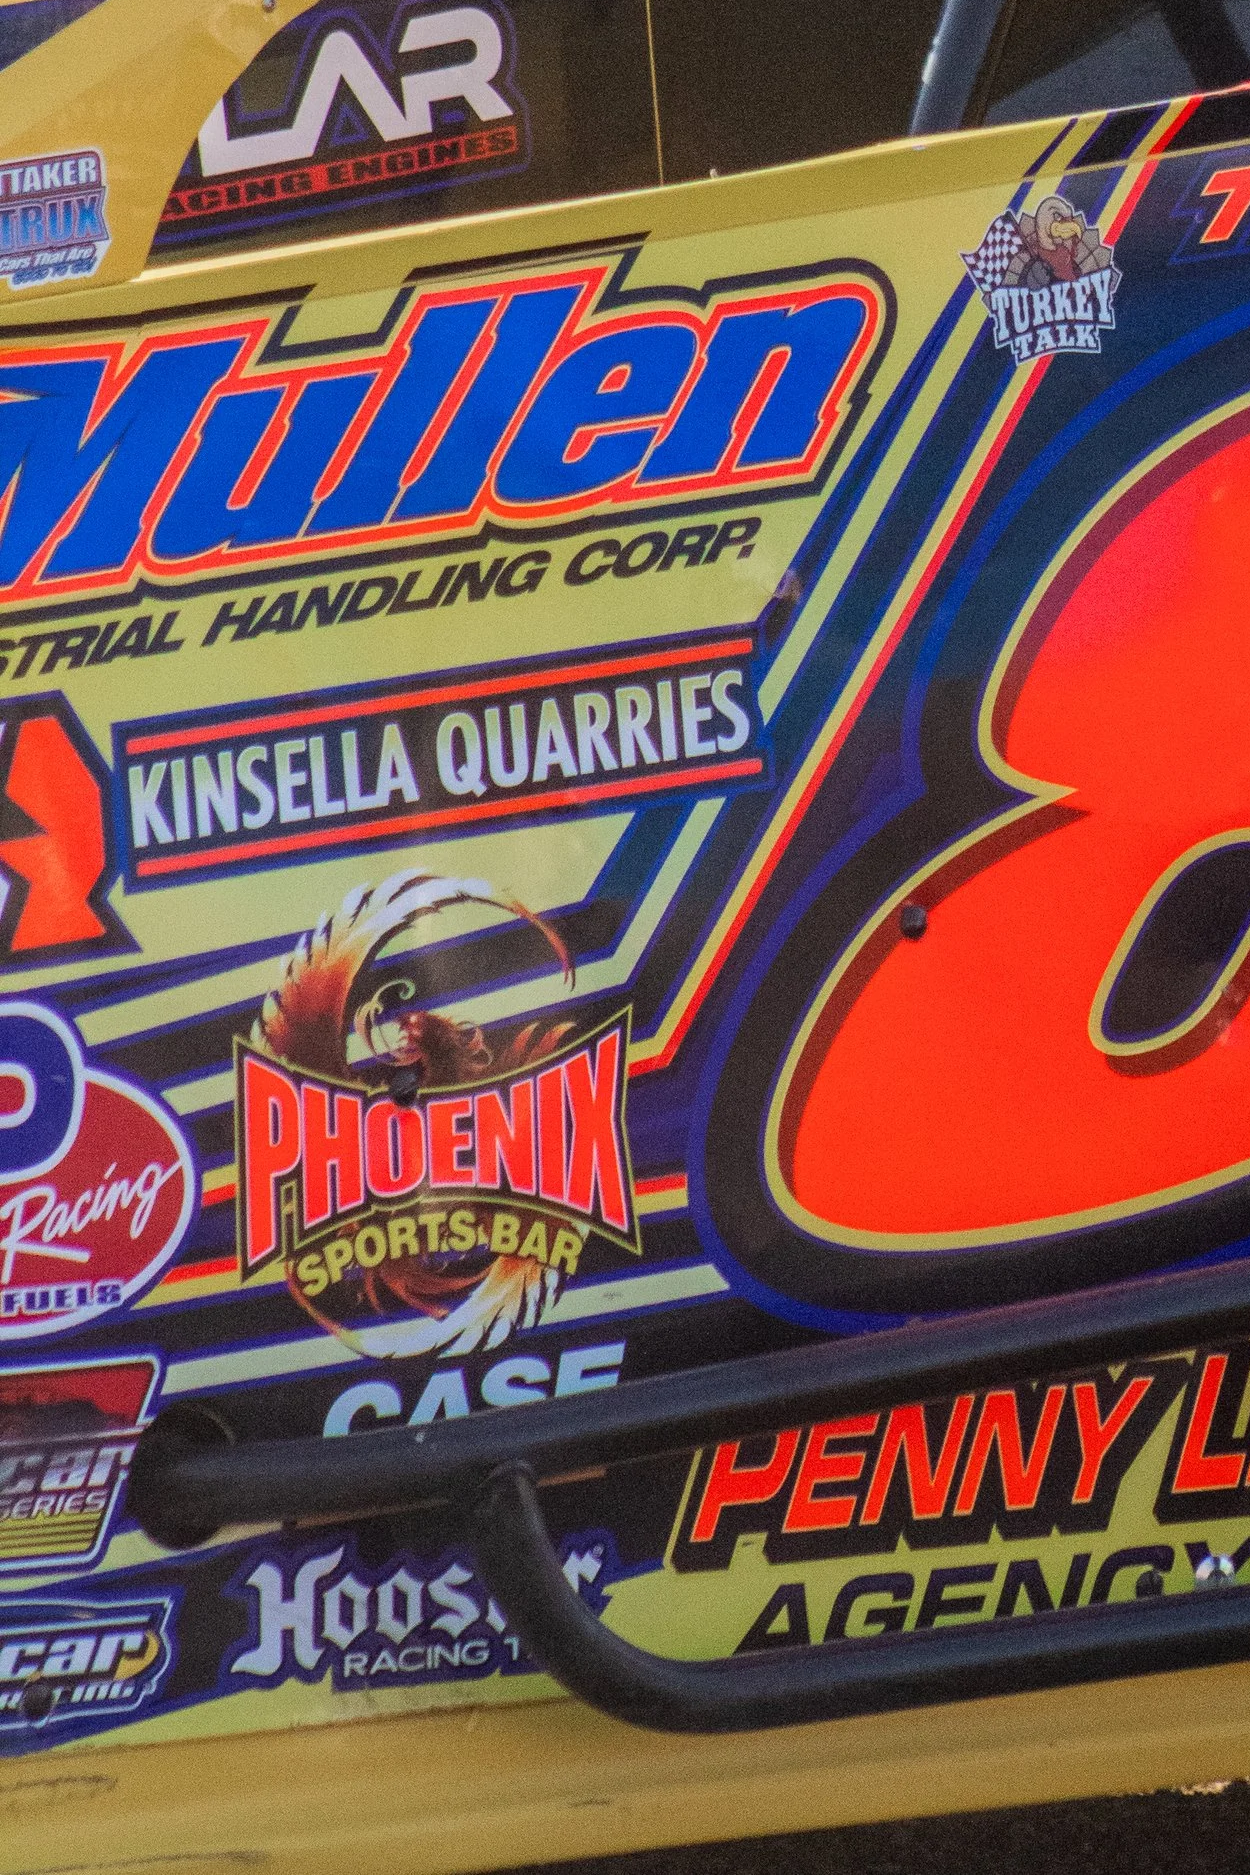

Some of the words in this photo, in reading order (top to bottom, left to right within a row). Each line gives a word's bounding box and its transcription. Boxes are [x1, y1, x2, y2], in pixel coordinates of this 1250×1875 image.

[327, 128, 516, 185] ENGINES
[991, 268, 1113, 342] TURKEY
[1014, 325, 1098, 359] TALK
[201, 549, 548, 647] HANDLING
[564, 516, 762, 586] CORP.
[127, 723, 419, 849] KINSELLA
[436, 669, 751, 796] QUARRIES
[243, 1027, 629, 1266] PHOENIX
[0, 1157, 187, 1285] Racing
[297, 1209, 476, 1297] SPORTS
[490, 1212, 584, 1275] BAR
[1, 1281, 122, 1314] FUELS
[690, 1375, 1153, 1543] PENNY
[344, 1640, 491, 1678] RACING
